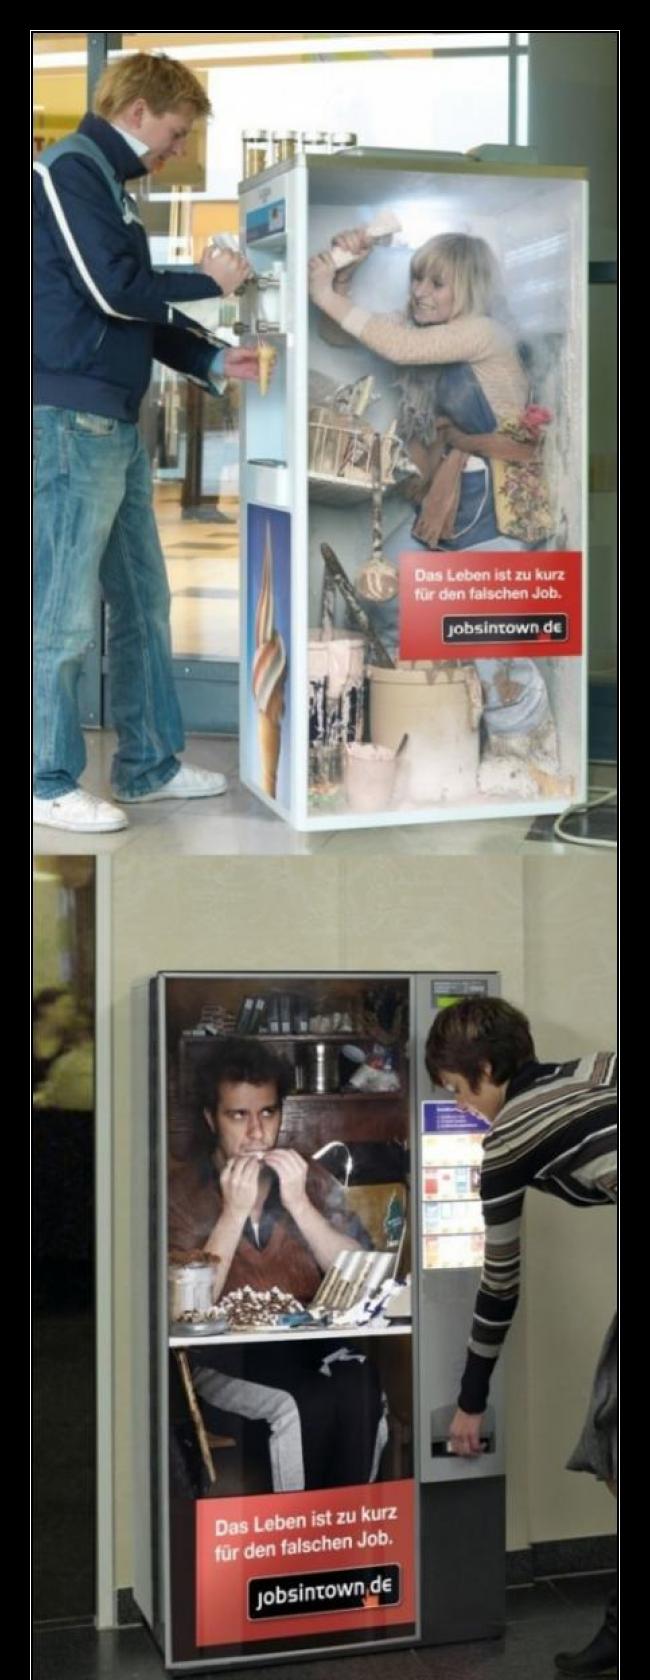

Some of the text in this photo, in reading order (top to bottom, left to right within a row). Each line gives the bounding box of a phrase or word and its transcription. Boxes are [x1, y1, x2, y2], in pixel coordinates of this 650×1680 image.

[415, 569, 565, 581] Das Leben ist zu kurz
[414, 587, 562, 601] für den falschen Job.
[215, 1506, 398, 1537] Das Leben ist zu kurz
[215, 1531, 393, 1562] für den falschen Job.
